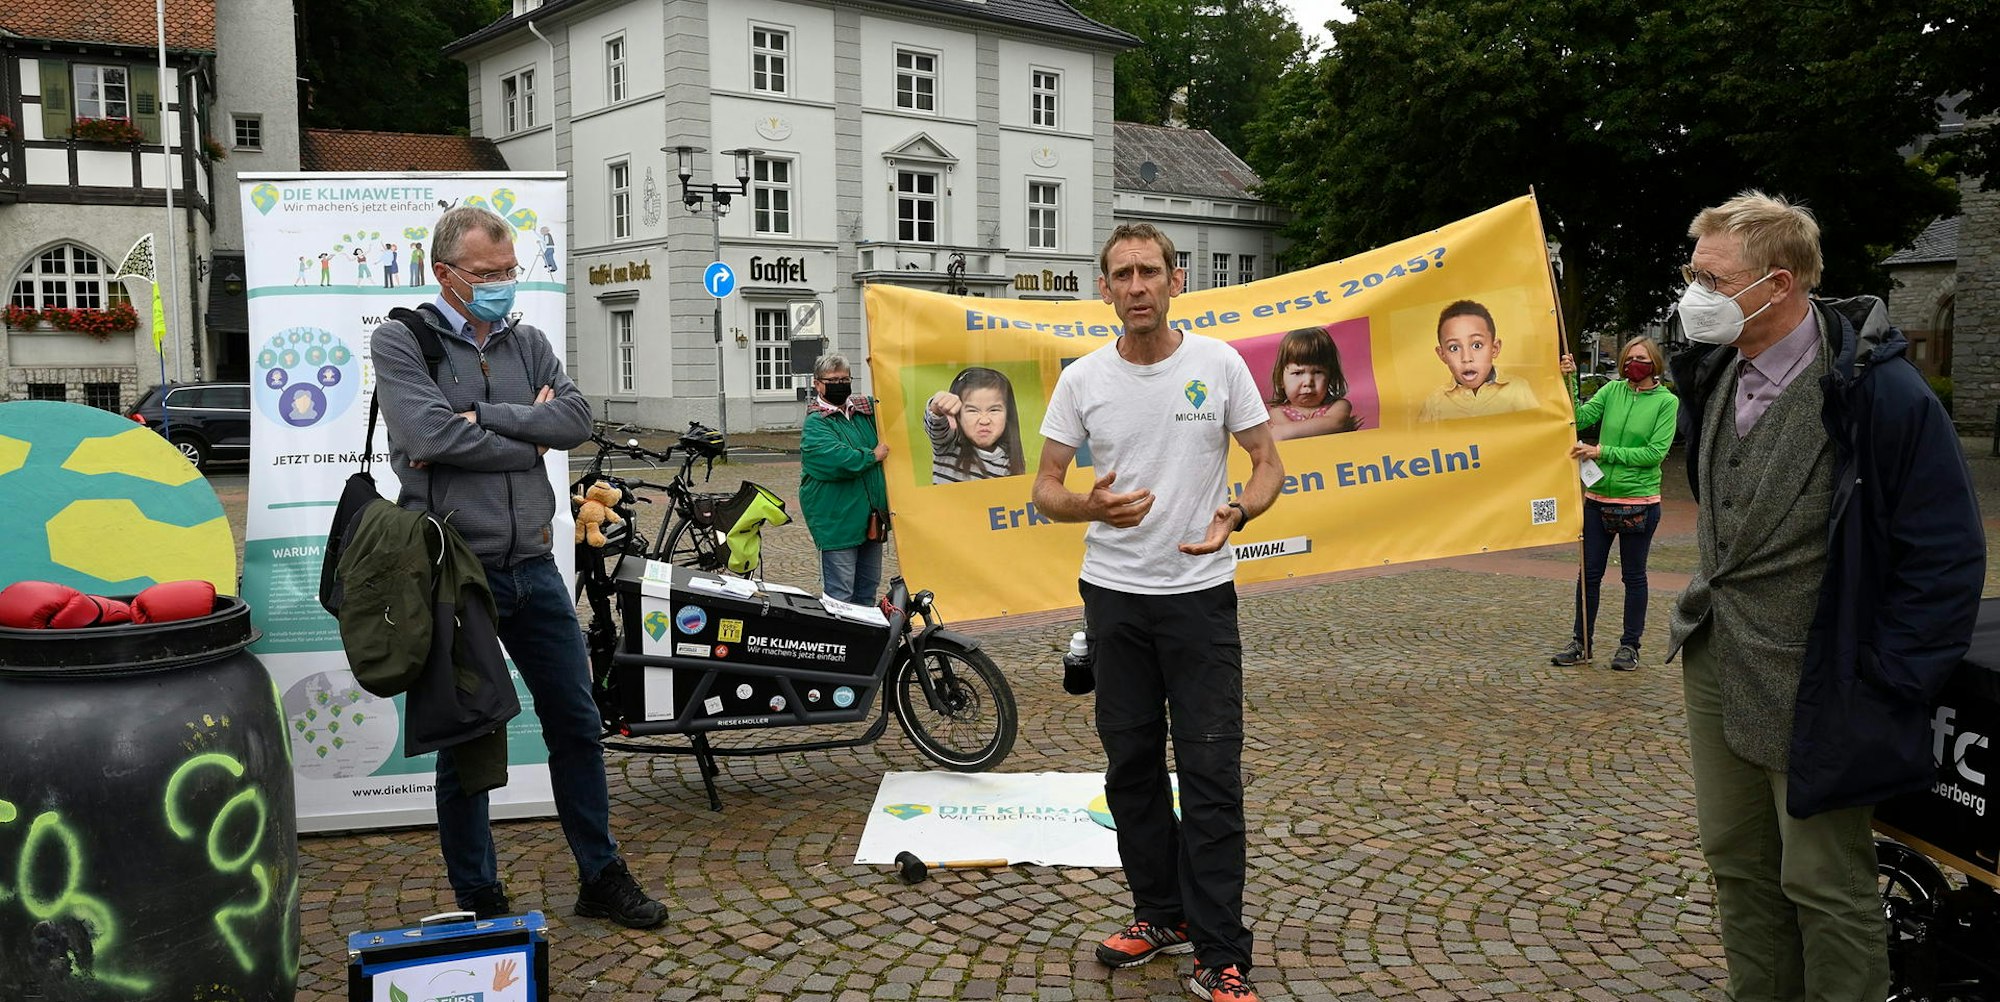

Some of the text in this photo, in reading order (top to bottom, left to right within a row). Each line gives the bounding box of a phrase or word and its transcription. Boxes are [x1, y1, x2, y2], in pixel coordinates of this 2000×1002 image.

[284, 187, 434, 201] DIE KLIMAWETTE
[284, 203, 304, 212] Wir
[362, 203, 387, 214] jetzt
[390, 201, 434, 211] einfach!
[589, 258, 652, 286] Gaffel am Bock
[750, 256, 808, 284] Gaffel
[1014, 269, 1079, 292] am Bock
[1252, 290, 1331, 318] erst
[1339, 247, 1447, 298] 2045?
[1175, 413, 1217, 421] MICHAEL
[273, 454, 310, 466] JETZT
[313, 454, 335, 464] DIE
[1335, 445, 1481, 487] Enkeln!
[272, 546, 320, 559] WARUM
[747, 645, 761, 653] Wir
[798, 651, 815, 659] jetzt
[748, 636, 847, 655] DIE KLIMAWETTE
[938, 805, 988, 815] DIE
